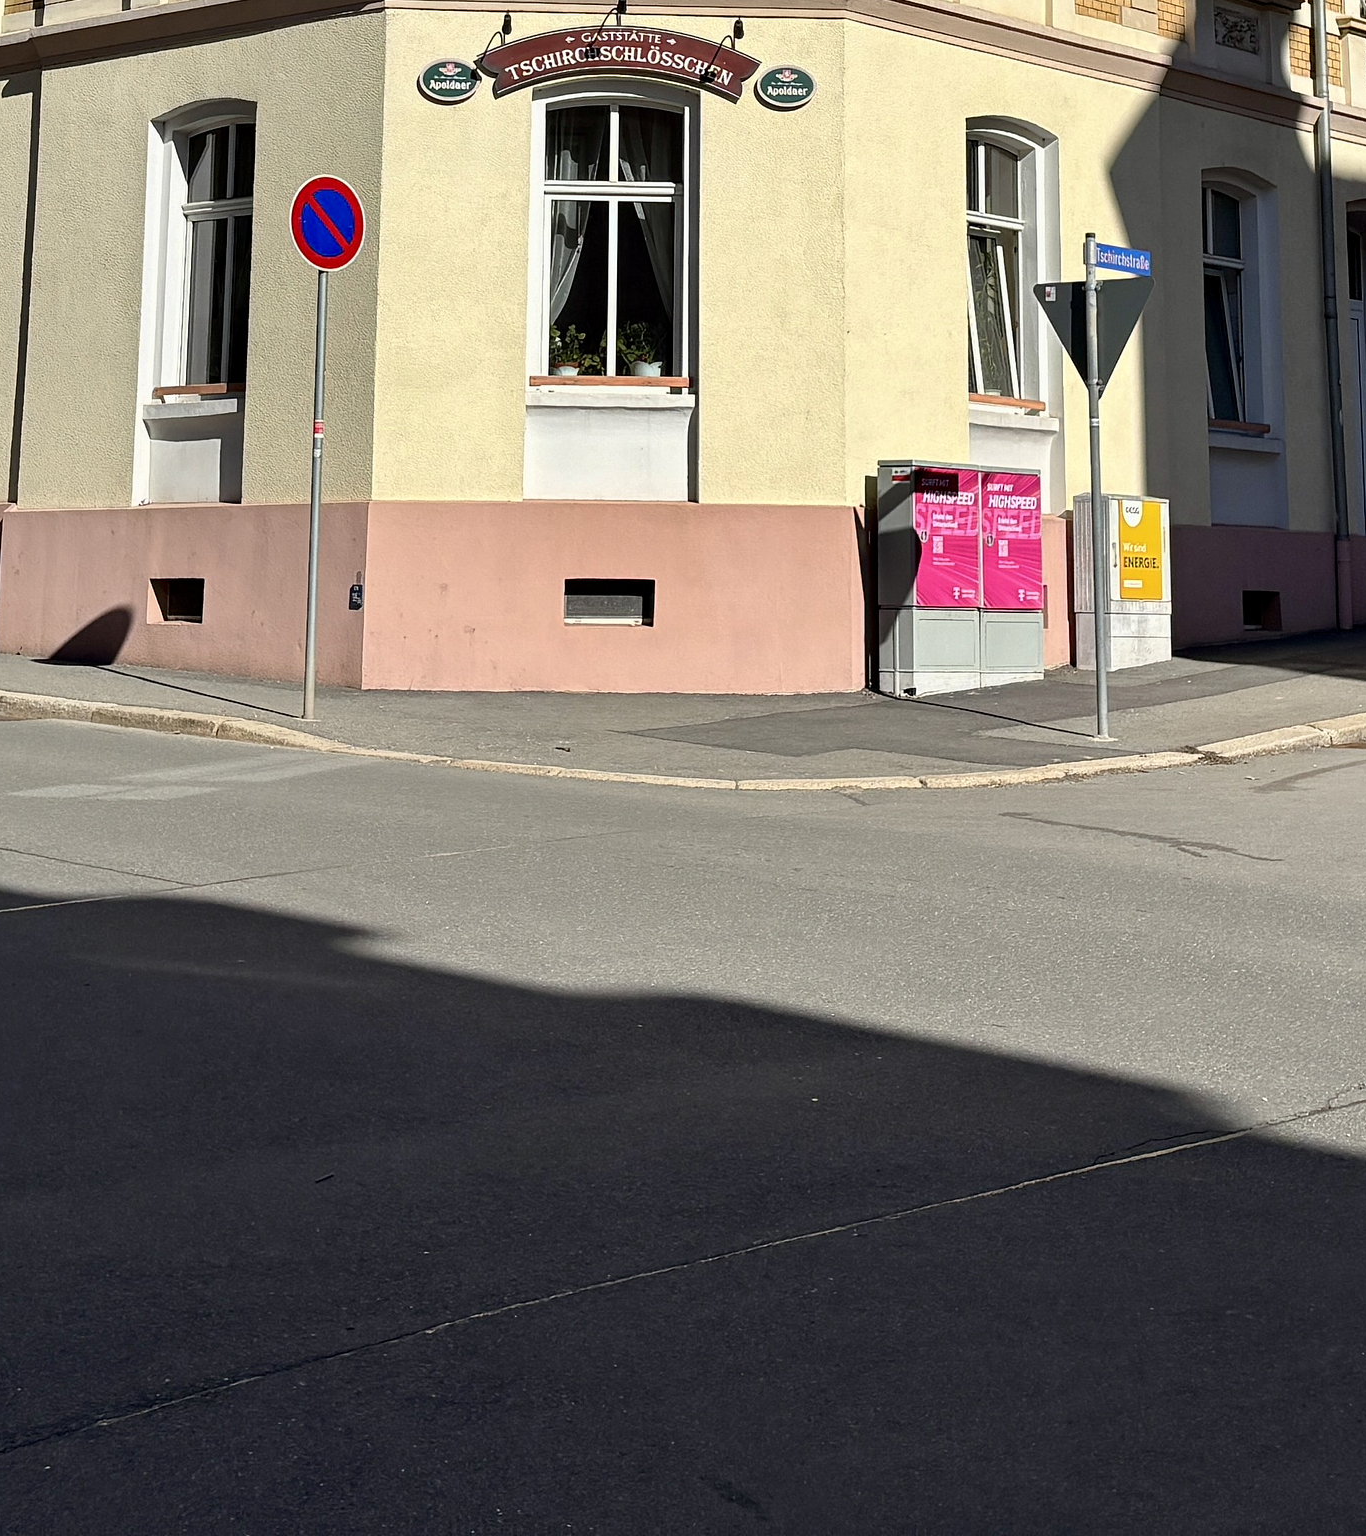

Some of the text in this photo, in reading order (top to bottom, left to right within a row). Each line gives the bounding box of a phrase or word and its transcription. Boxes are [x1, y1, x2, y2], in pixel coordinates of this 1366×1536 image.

[505, 45, 733, 86] TSCHIRCHSCHLÖSSCHEN
[429, 79, 471, 91] Apoldaer
[767, 85, 808, 96] Apoldaer
[1096, 247, 1150, 271] Tschirchstraße
[923, 490, 975, 505] HIGHSPEED
[988, 494, 1037, 510] HIGHSPEED
[1123, 556, 1159, 569] ENERGIE.
